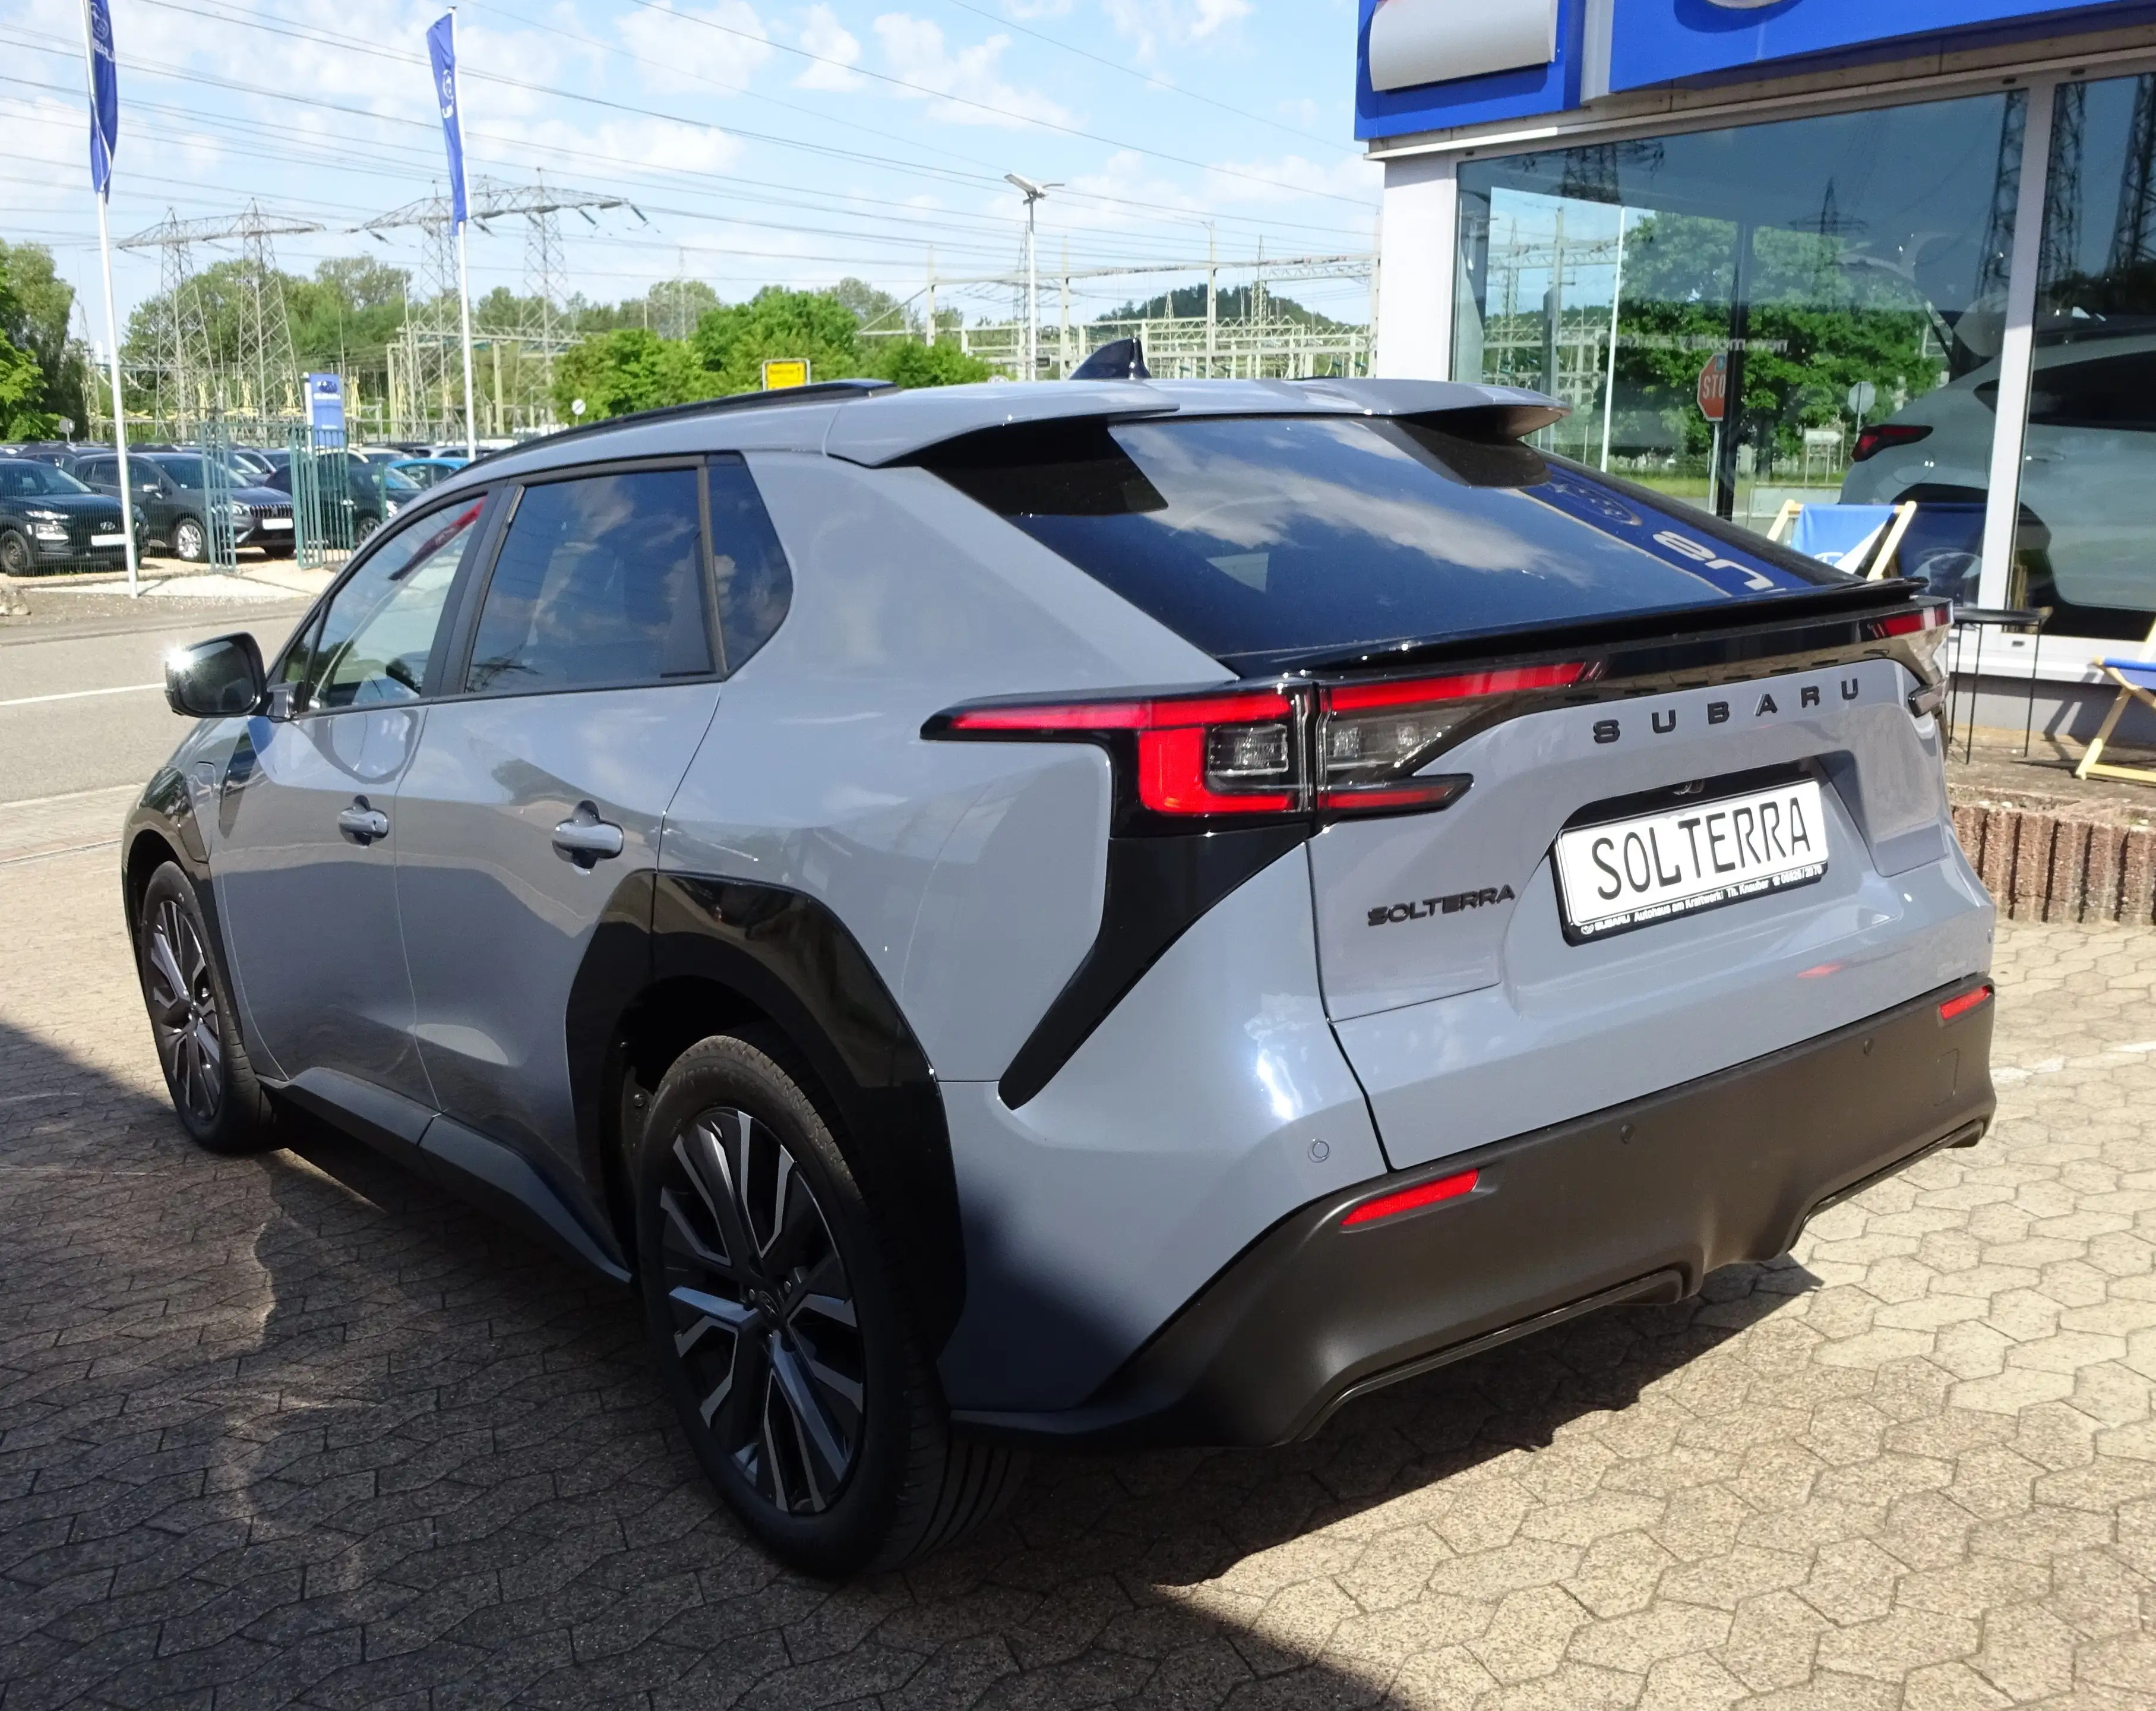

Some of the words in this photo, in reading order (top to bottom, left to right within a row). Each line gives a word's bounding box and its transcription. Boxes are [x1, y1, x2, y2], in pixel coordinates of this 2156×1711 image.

[1703, 374, 1726, 400] STO
[1594, 678, 1858, 744] SUBARU
[1592, 797, 1811, 901] SOLTERRA
[1367, 883, 1516, 927] SOLTERRA
[1595, 915, 1630, 931] SUBARU
[1634, 904, 1671, 922] Autohaus
[1672, 901, 1684, 912] am
